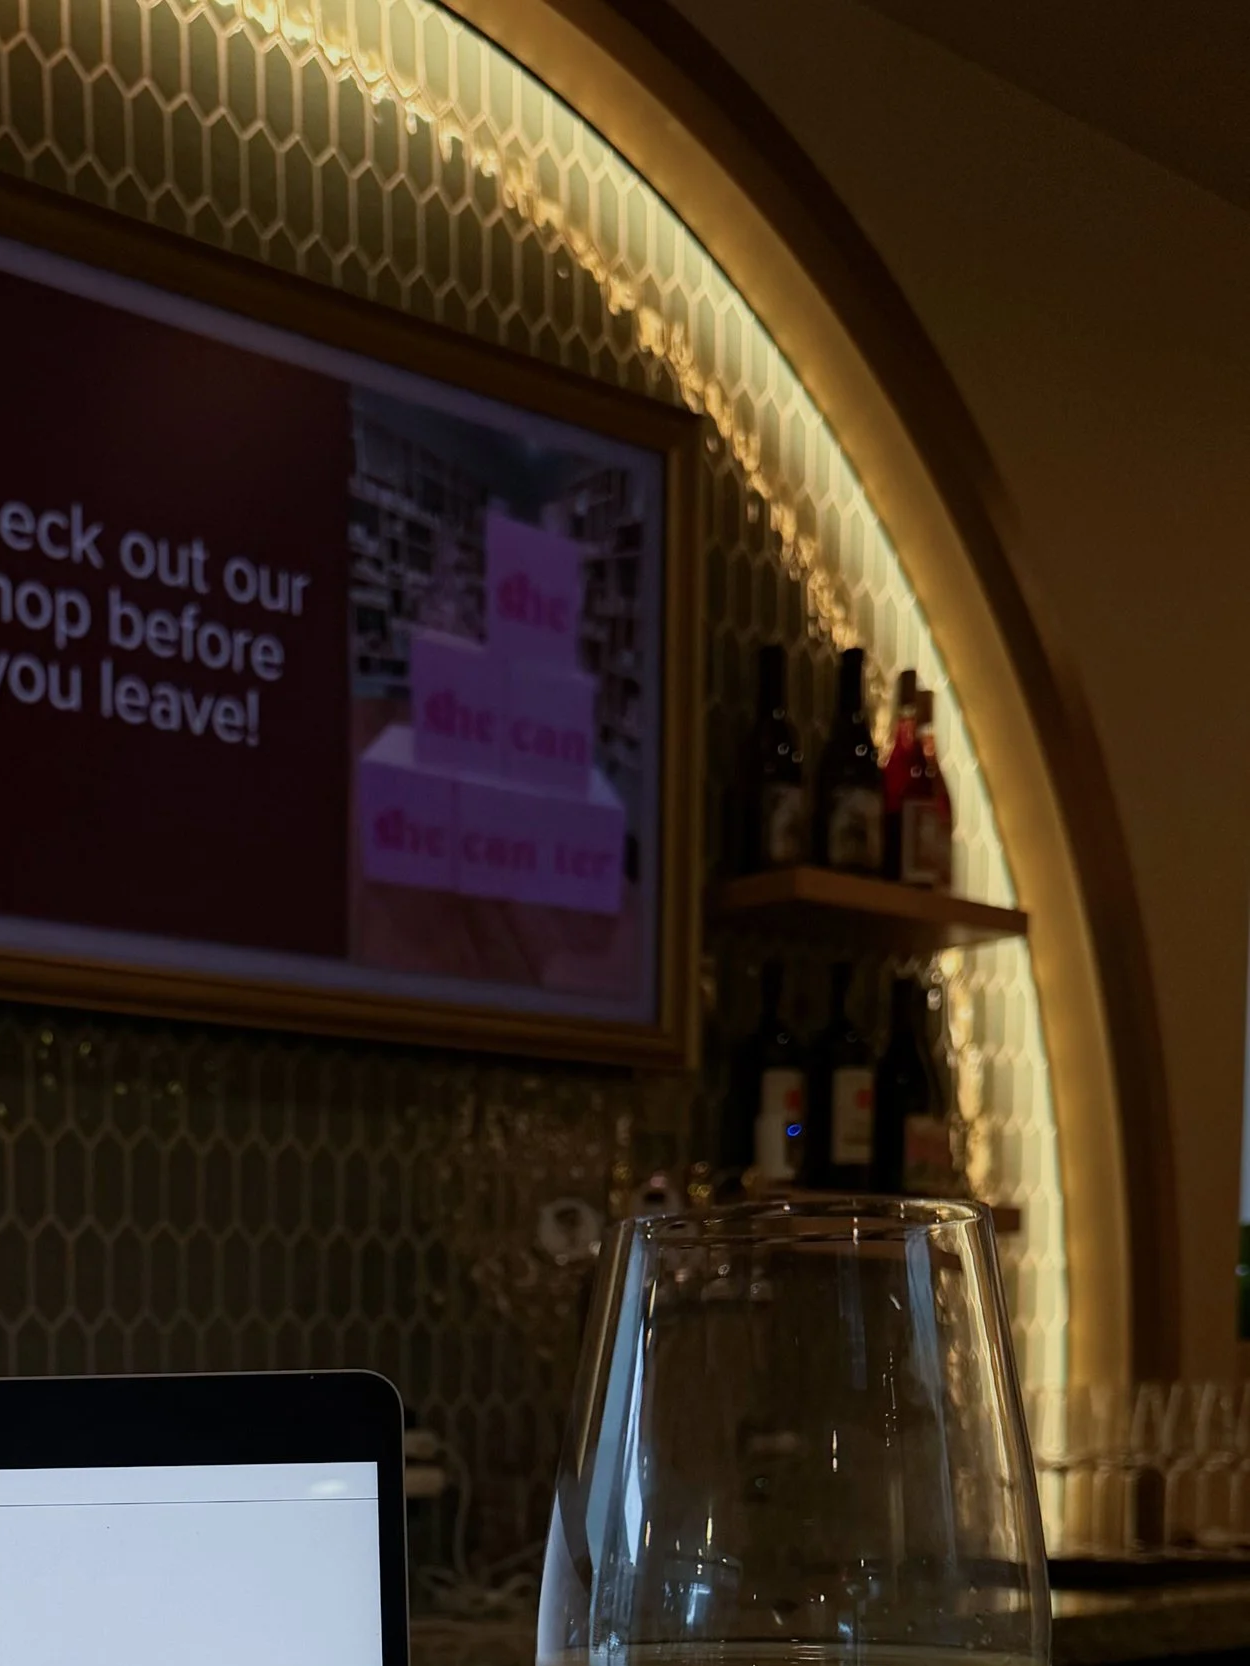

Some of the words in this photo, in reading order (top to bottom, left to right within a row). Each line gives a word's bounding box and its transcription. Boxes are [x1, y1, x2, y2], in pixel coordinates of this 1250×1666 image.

[119, 530, 209, 596] out
[223, 557, 311, 616] our
[109, 586, 285, 681] before
[100, 657, 262, 747] leave!
